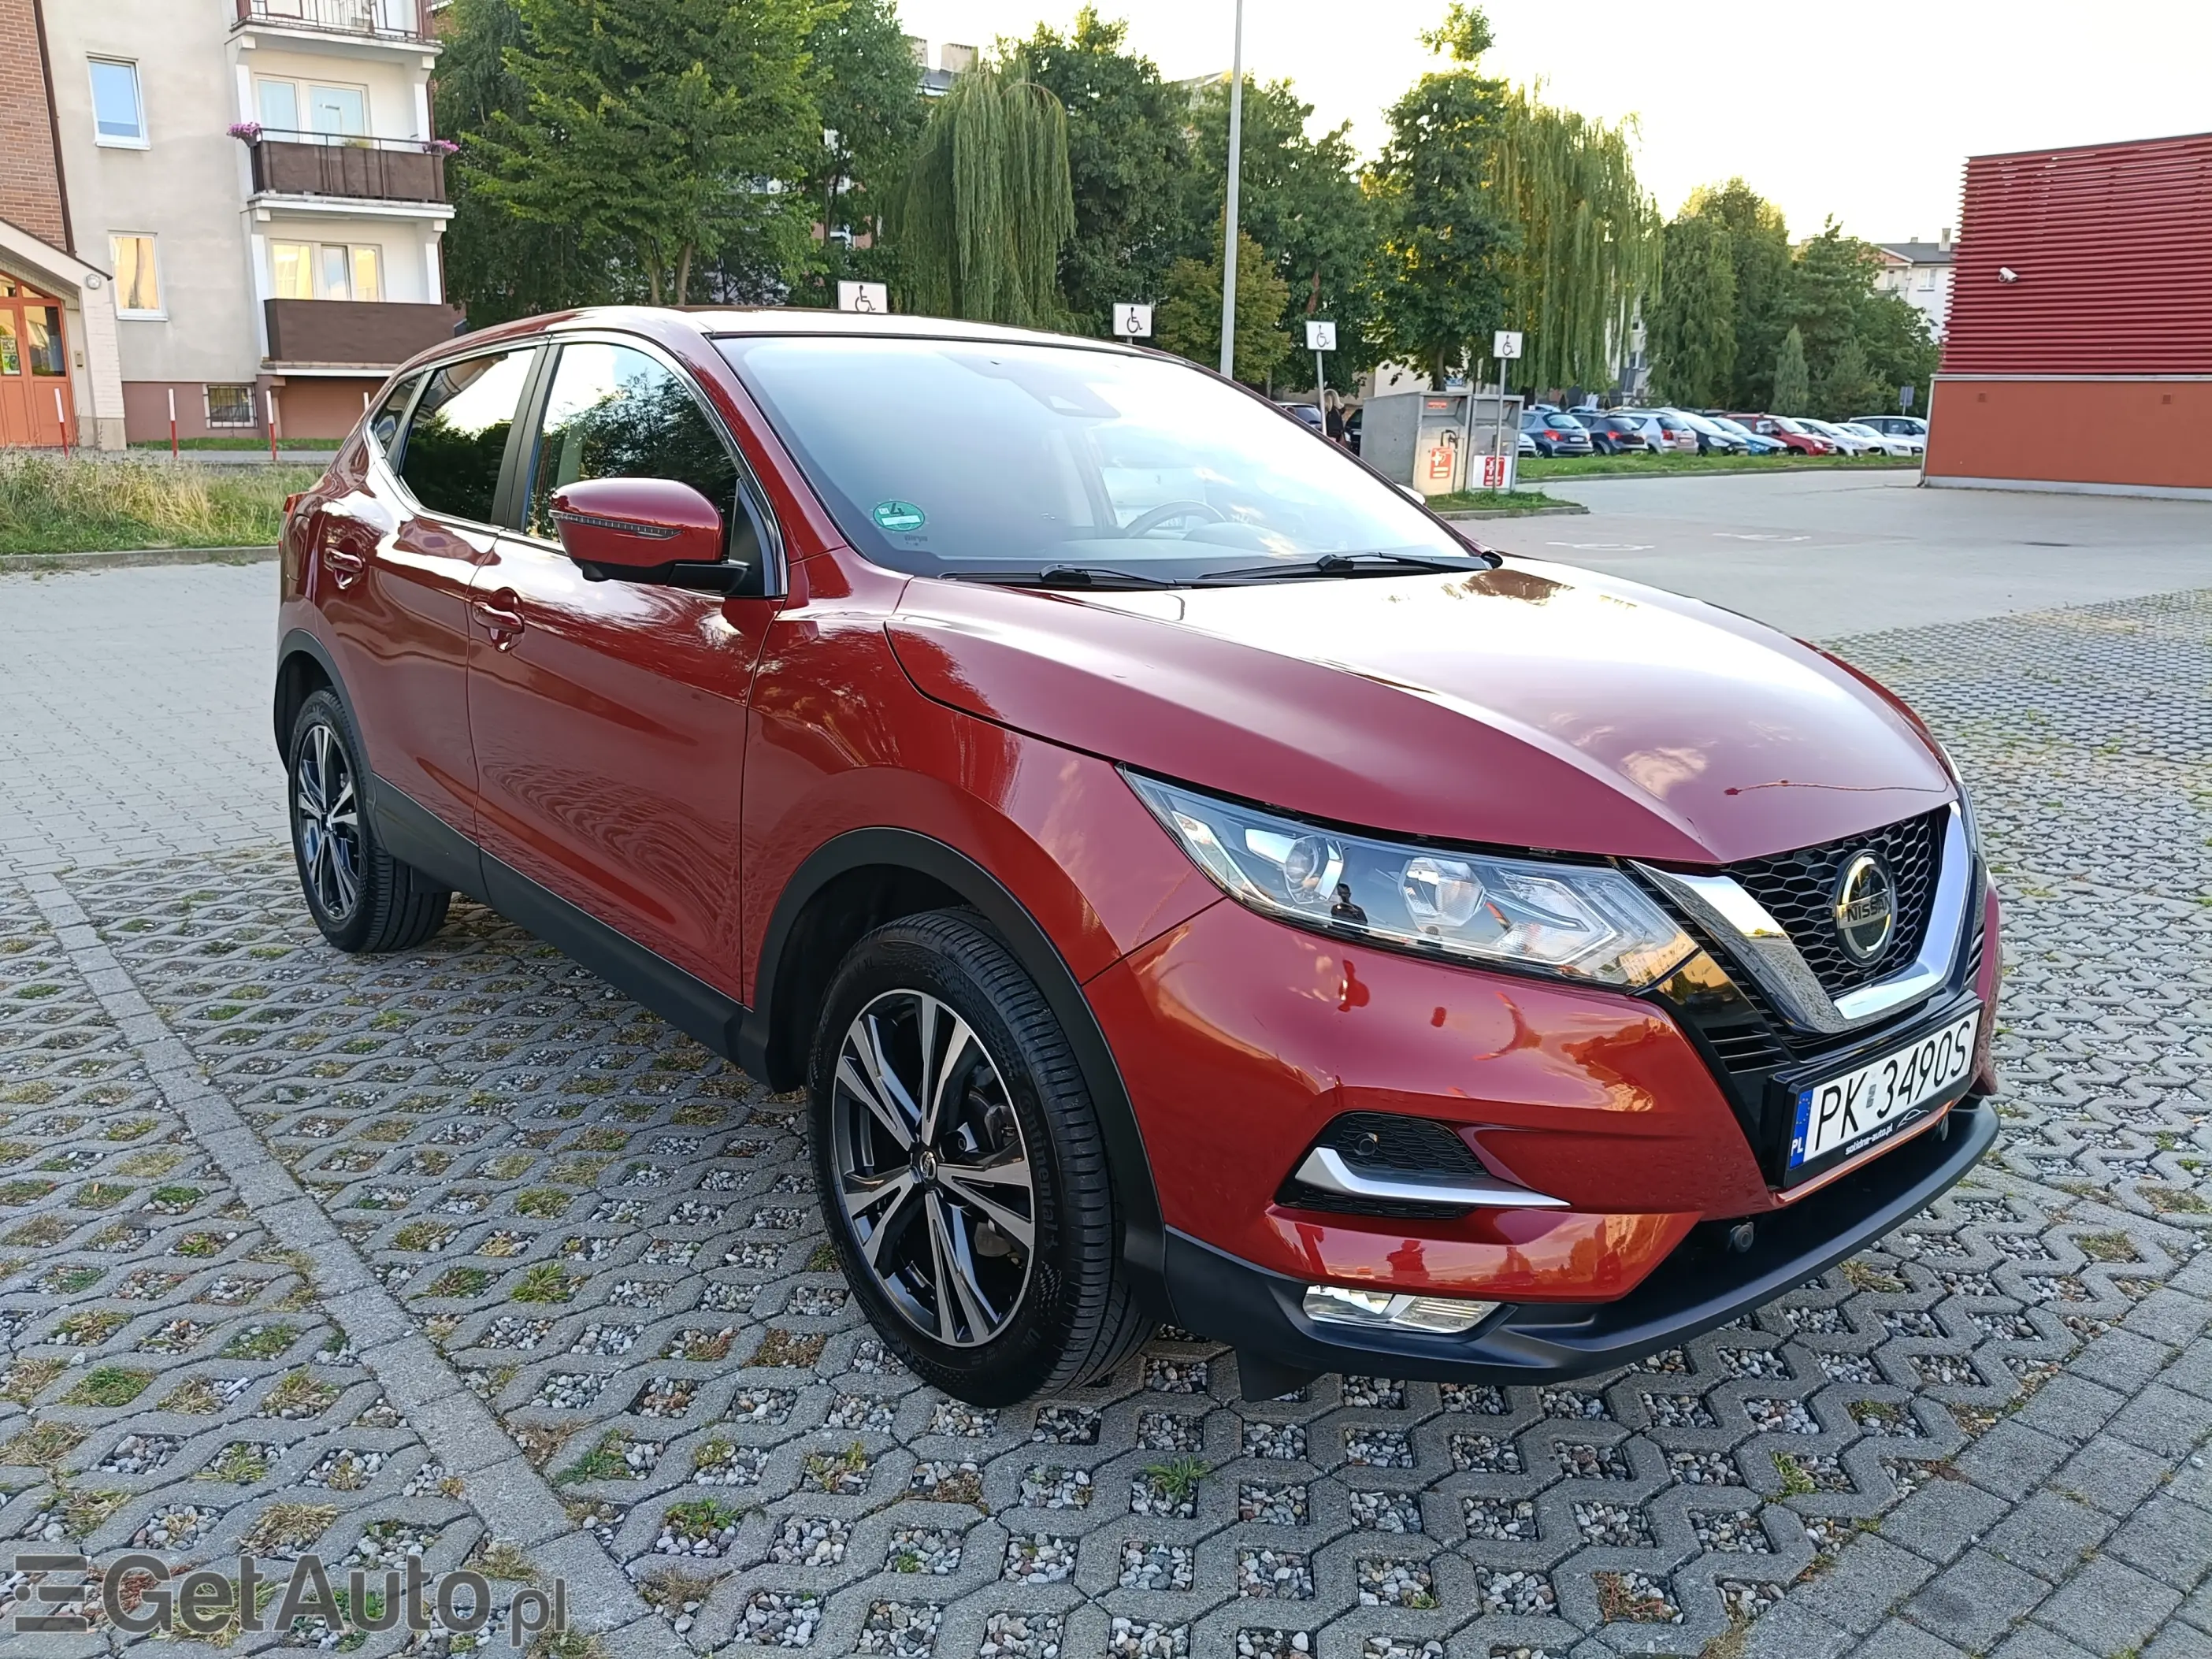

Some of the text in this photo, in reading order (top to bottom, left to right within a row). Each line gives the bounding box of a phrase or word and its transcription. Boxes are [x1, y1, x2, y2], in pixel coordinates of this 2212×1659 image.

[890, 503, 905, 516] 4
[1846, 896, 1891, 922] NISSAN
[1814, 1020, 1971, 1152] PK 3490S
[1791, 1138, 1804, 1156] PL
[1845, 1123, 1894, 1156] solidne-auto.pl
